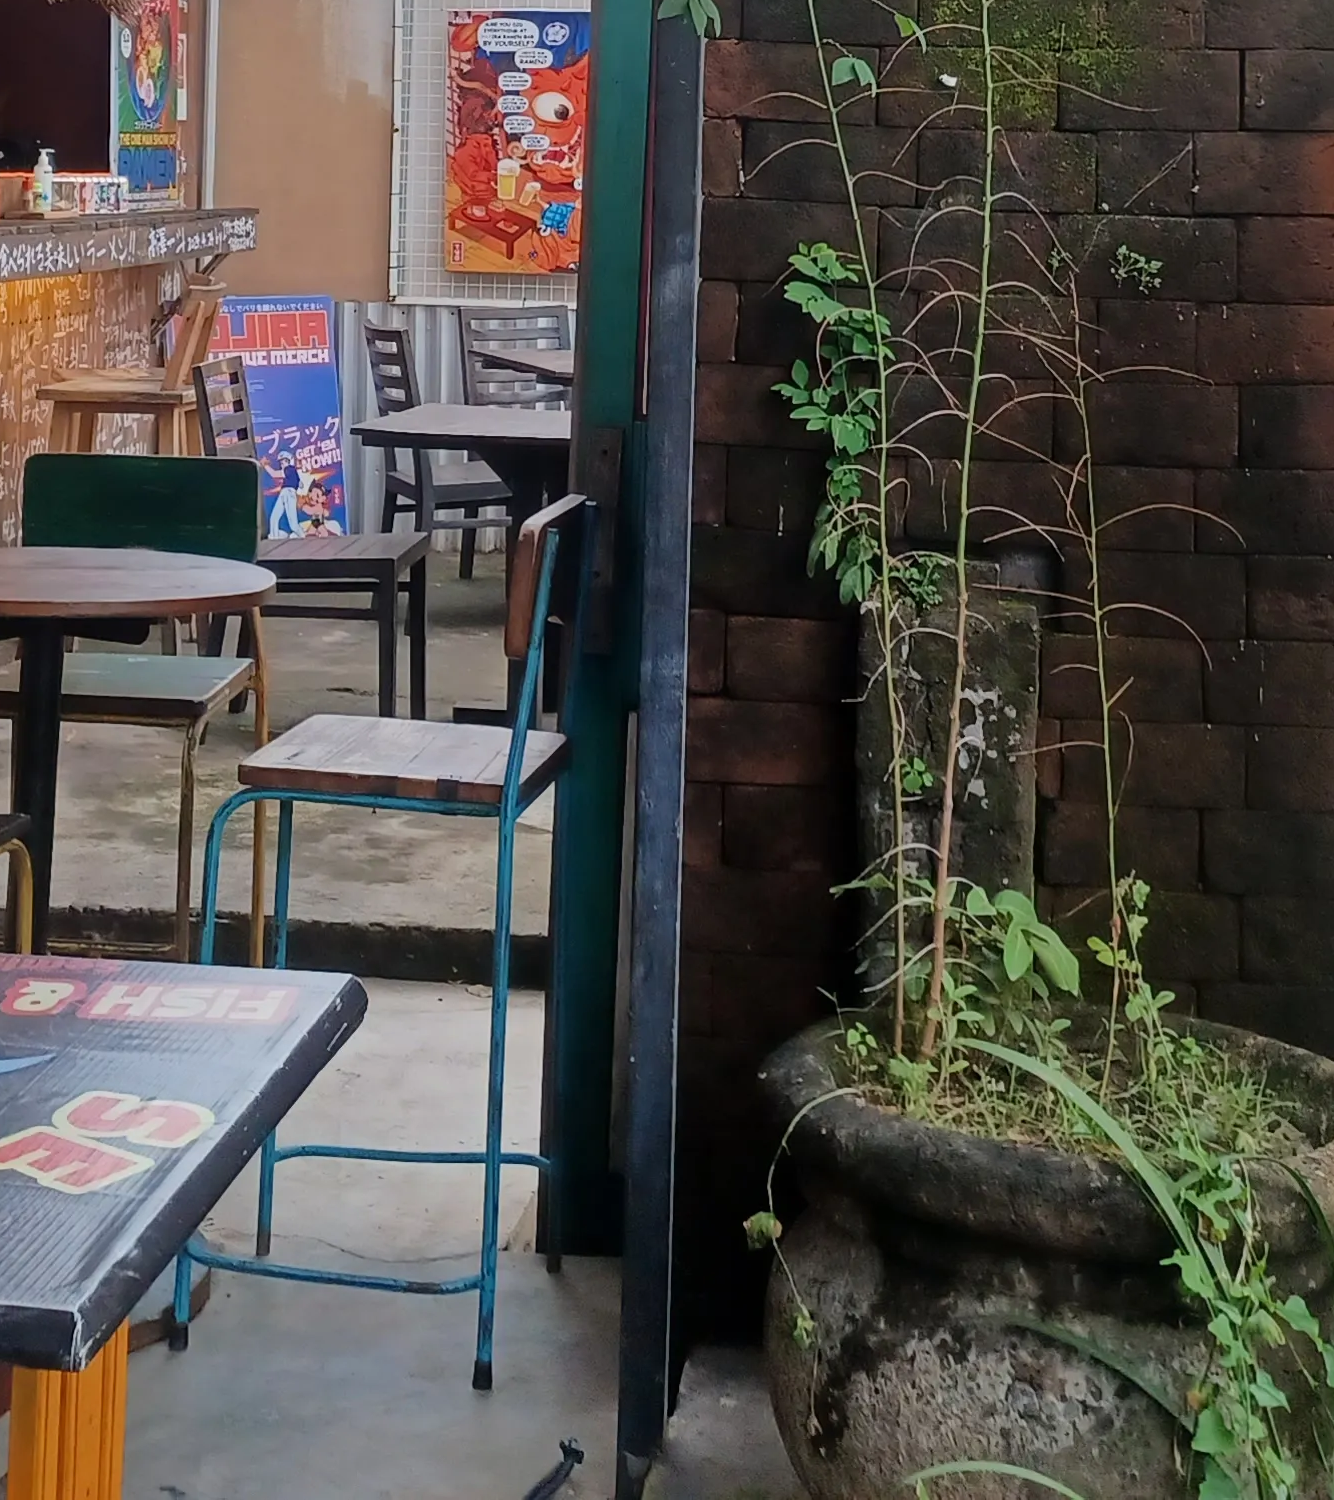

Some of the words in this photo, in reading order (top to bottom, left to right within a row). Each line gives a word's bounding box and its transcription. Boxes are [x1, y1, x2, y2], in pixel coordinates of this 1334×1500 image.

[270, 349, 330, 366] MERCH
[265, 415, 342, 454] ブラック
[295, 445, 317, 459] GET
[0, 977, 87, 1017] &
[77, 980, 301, 1022] FISH
